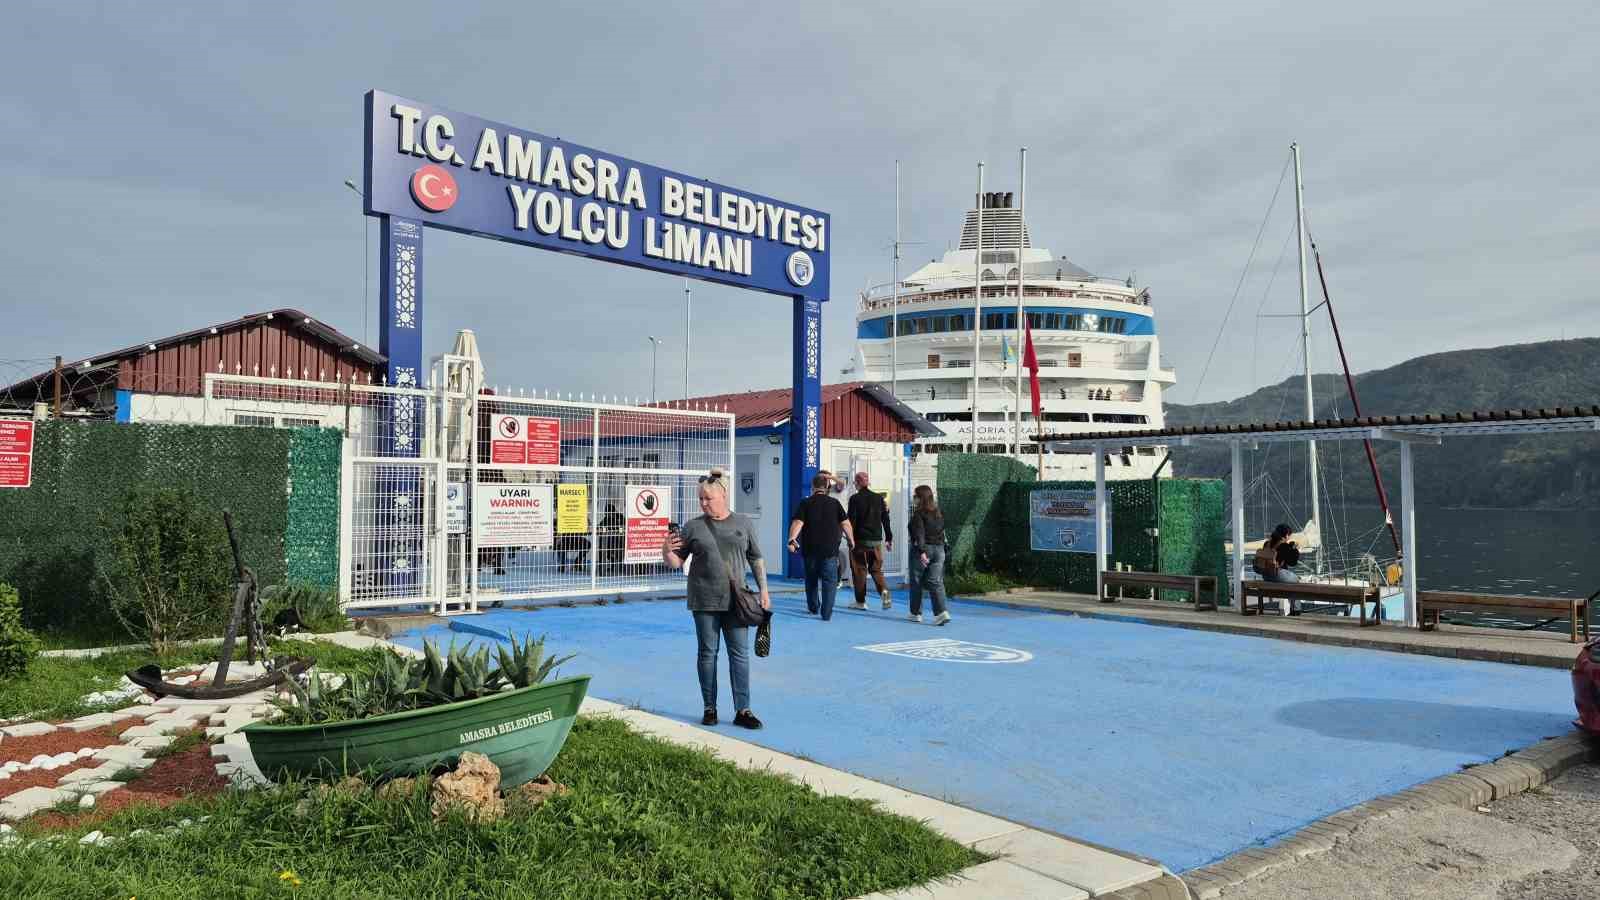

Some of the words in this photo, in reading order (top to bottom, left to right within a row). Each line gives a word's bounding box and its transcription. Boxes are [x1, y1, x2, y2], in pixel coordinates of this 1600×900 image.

[391, 104, 465, 165] T.C.
[472, 128, 647, 209] AMASRA
[661, 175, 825, 252] BELEDİYESİ
[507, 185, 630, 249] YOLCU
[643, 217, 752, 276] LİMANI
[959, 426, 1006, 434] ASORIA
[490, 499, 541, 508] WARNING
[500, 489, 531, 498] UYARI
[460, 726, 498, 744] AMASRA
[498, 707, 554, 735] BELEDİYESİ
